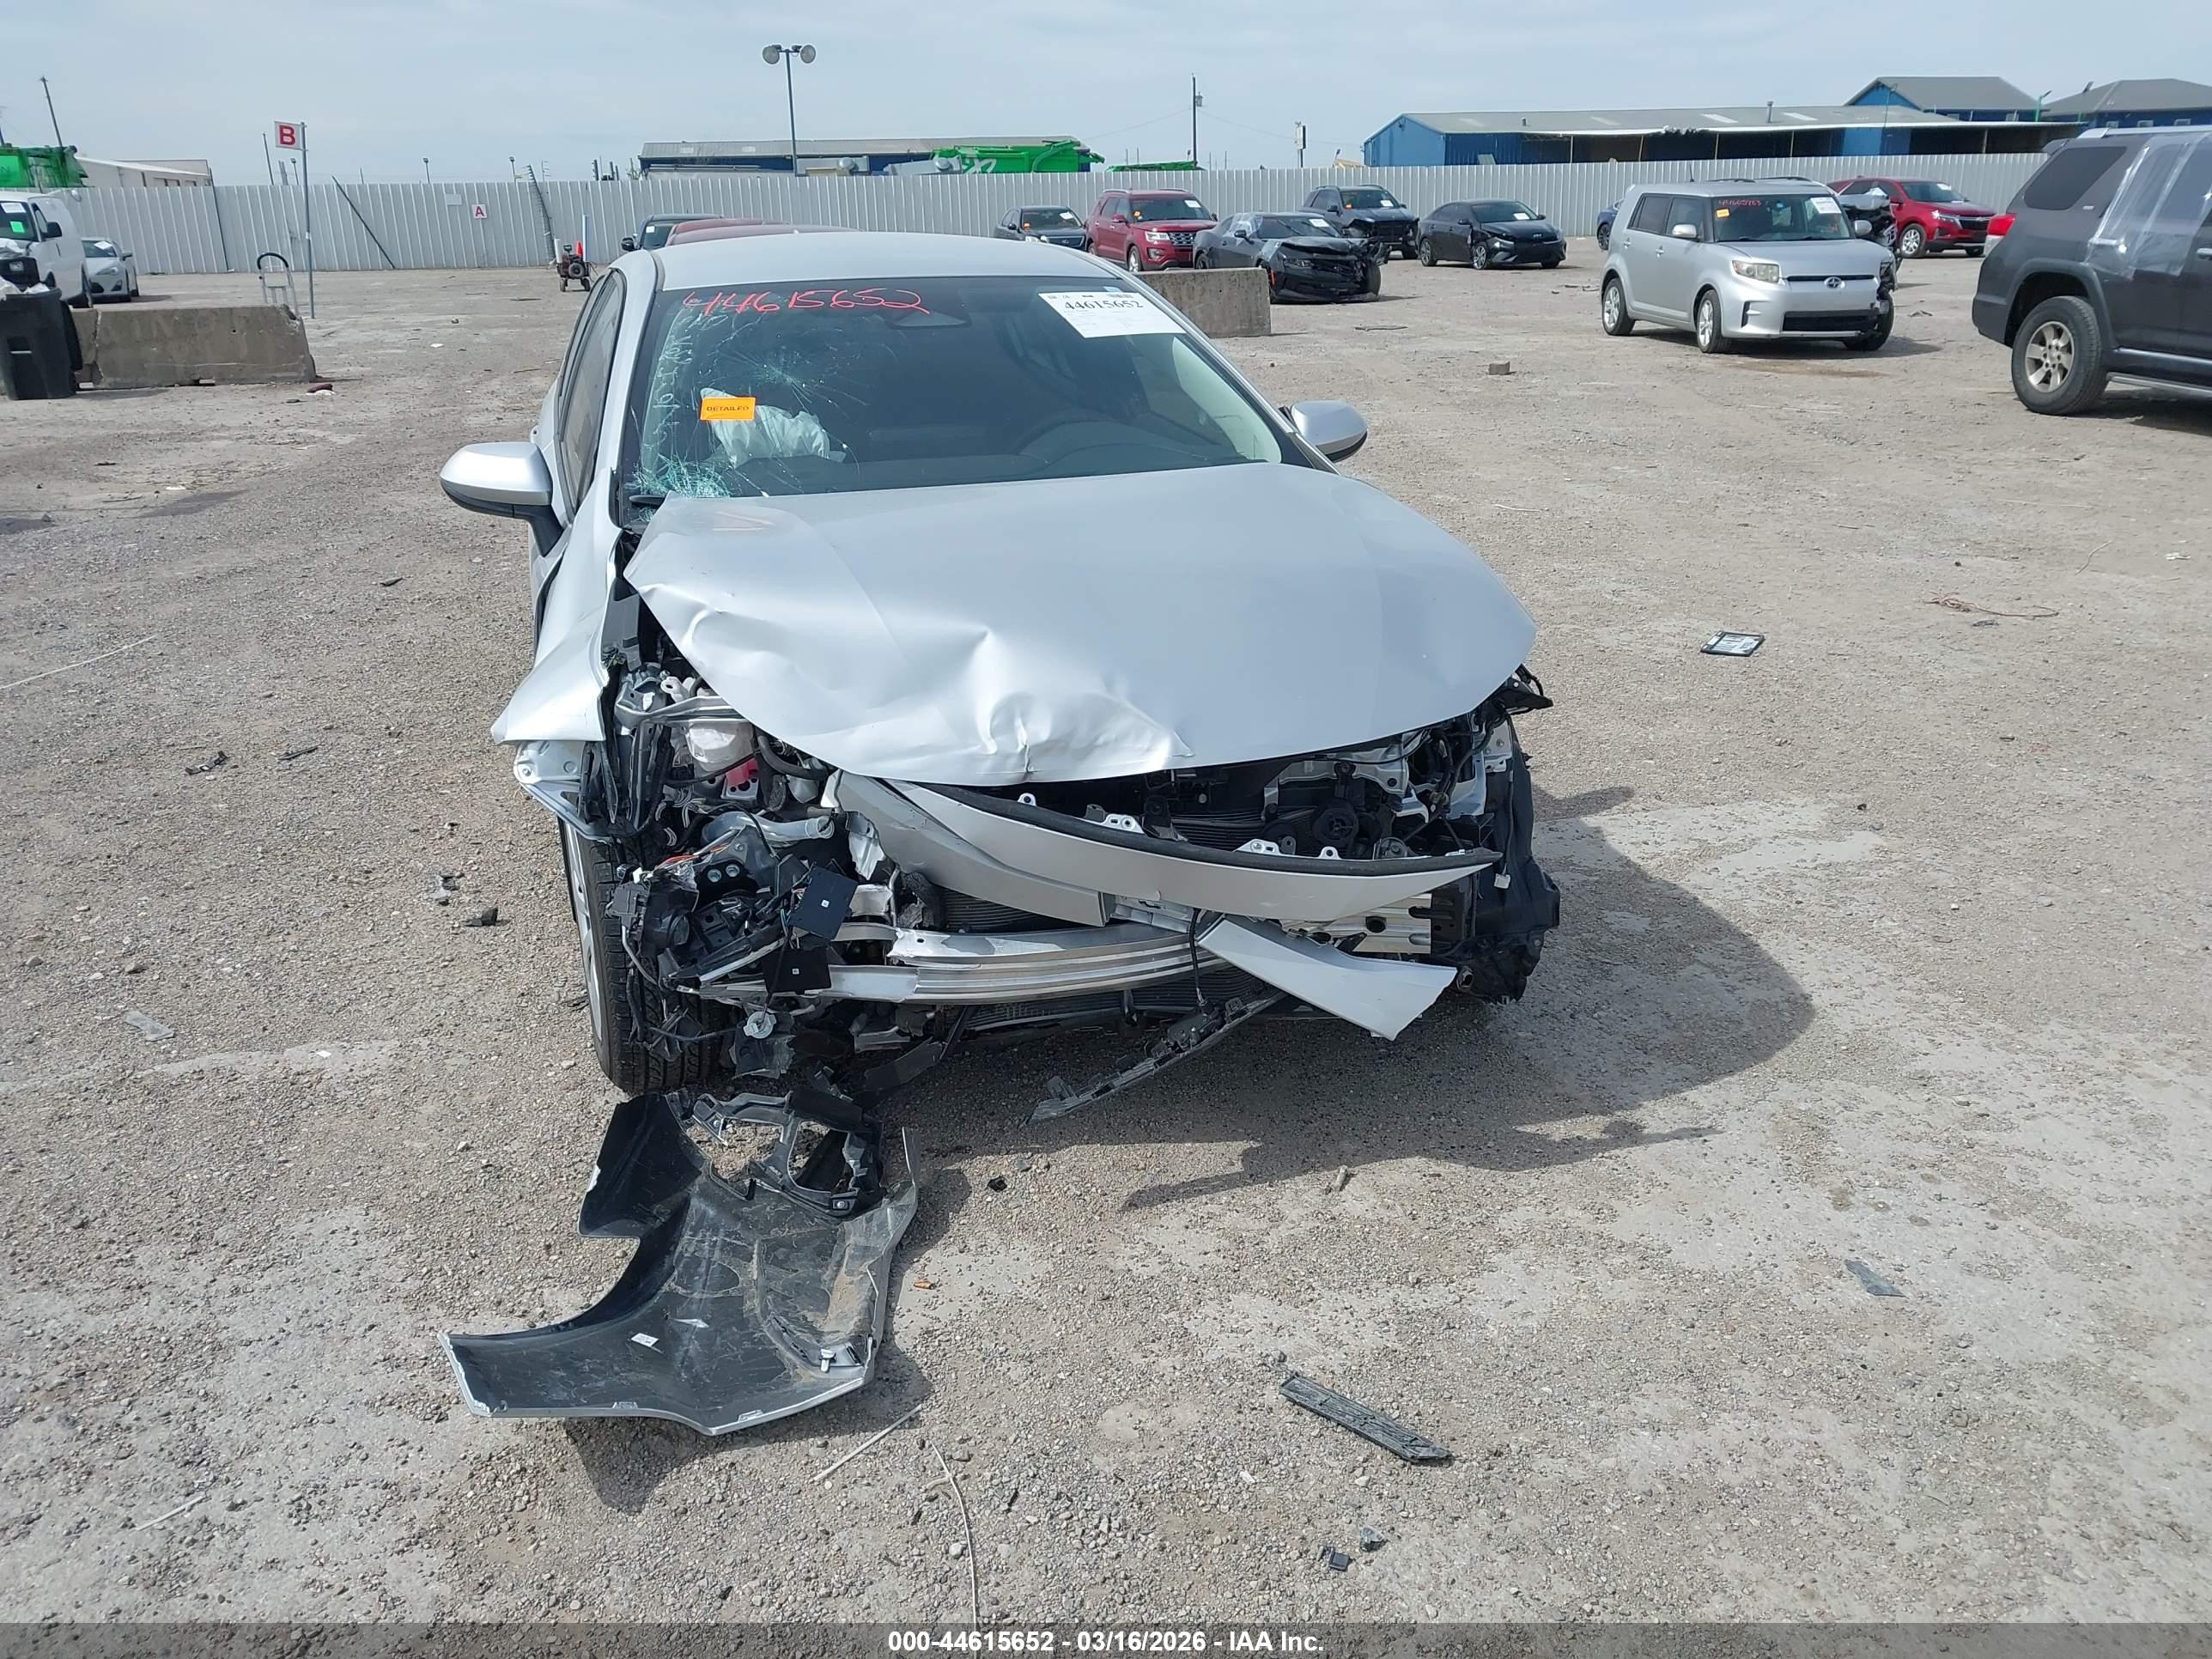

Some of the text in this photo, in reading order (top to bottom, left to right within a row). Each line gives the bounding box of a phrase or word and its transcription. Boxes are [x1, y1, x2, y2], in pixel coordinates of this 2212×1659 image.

[279, 125, 295, 145] B
[475, 205, 485, 217] A
[683, 289, 930, 316] 44615652
[1065, 301, 1144, 310] 44615652
